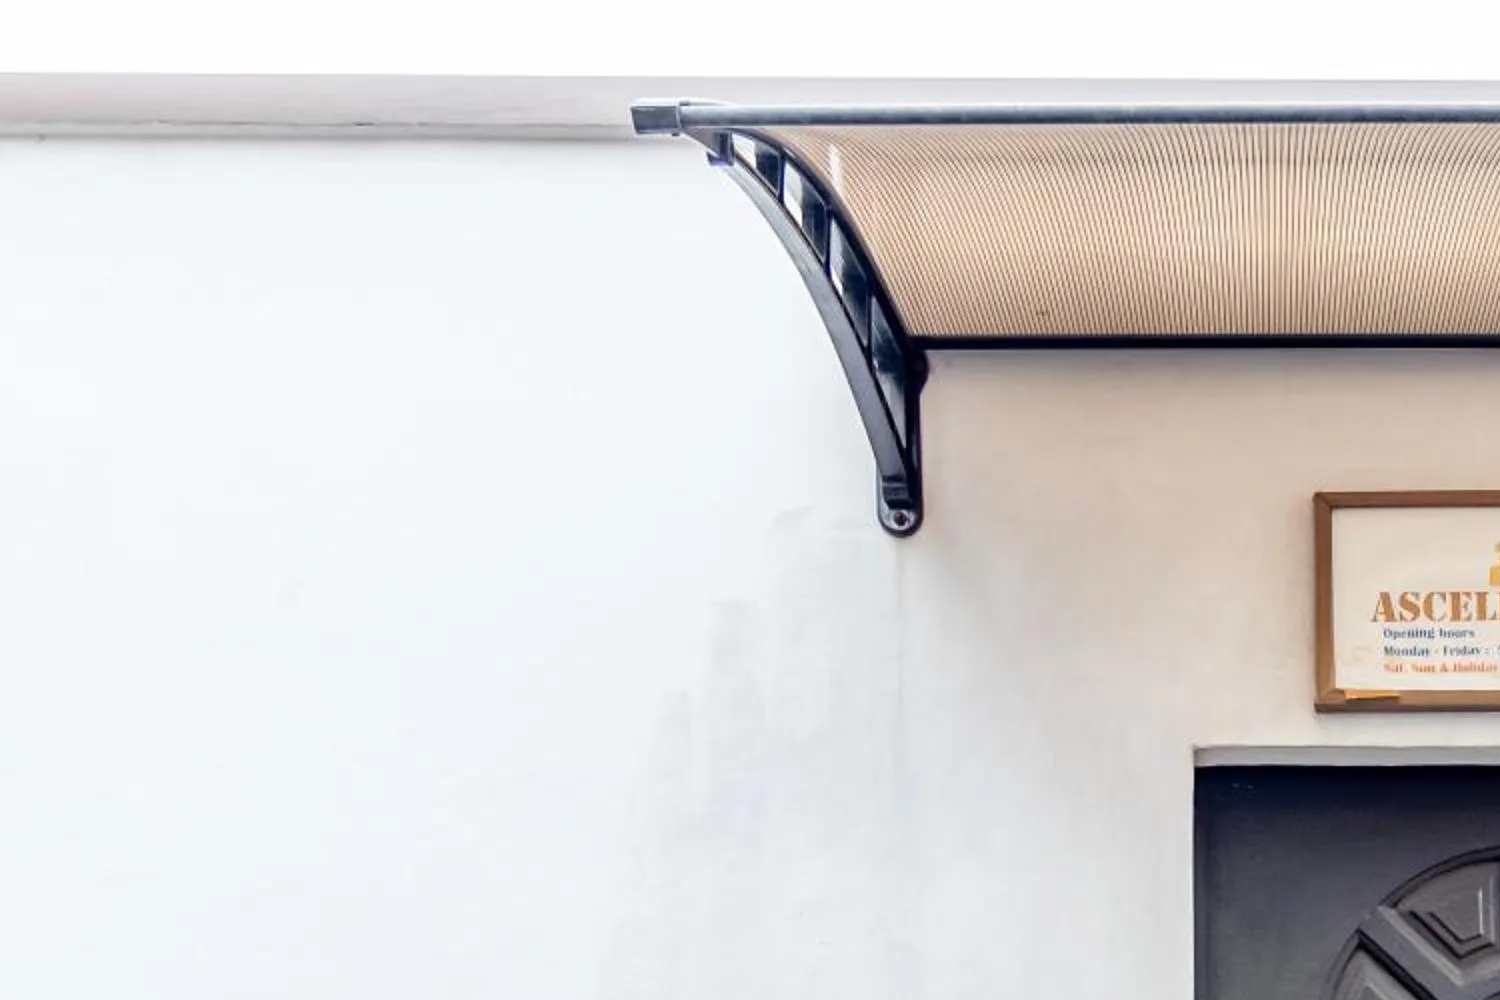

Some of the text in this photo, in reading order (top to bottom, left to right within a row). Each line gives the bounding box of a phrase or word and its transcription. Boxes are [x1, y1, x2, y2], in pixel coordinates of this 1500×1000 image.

[1383, 627, 1475, 639] Opening hours
[1383, 645, 1430, 656] Monday
[1443, 644, 1481, 656] Friday
